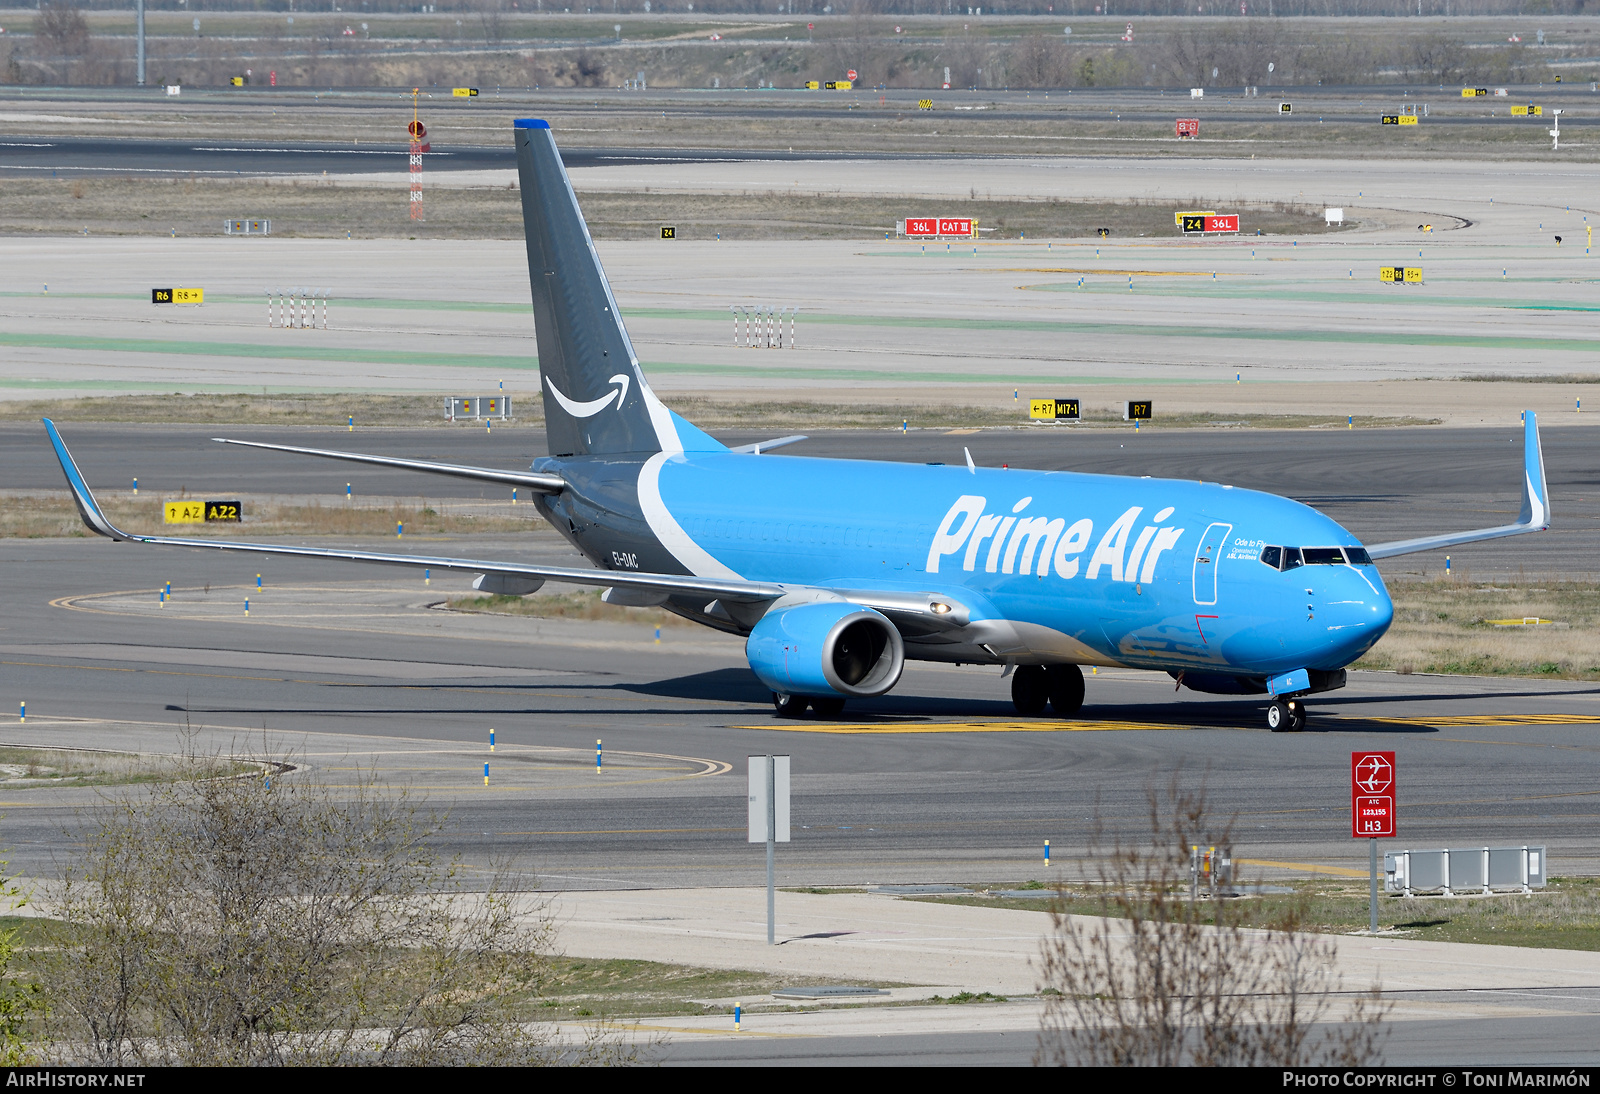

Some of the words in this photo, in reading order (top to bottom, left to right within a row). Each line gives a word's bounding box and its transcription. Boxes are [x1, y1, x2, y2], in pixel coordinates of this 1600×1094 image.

[913, 222, 929, 231] 36L
[942, 222, 958, 231] CAT
[960, 222, 968, 231] III
[1187, 219, 1201, 229] Z4
[1212, 219, 1231, 228] 36L
[664, 229, 672, 237] Z4
[156, 291, 169, 301] R6
[177, 291, 189, 300] R8
[1042, 403, 1052, 414] R7
[1057, 403, 1078, 415] M17-1
[1134, 404, 1147, 416] R7
[182, 507, 200, 519] AZ
[209, 505, 237, 519] AZ2
[926, 494, 1093, 580] Prime
[1085, 506, 1185, 584] Air
[1234, 538, 1248, 547] Ode
[1249, 539, 1255, 547] to
[1256, 540, 1266, 550] Fly
[612, 551, 639, 569] EI-DAC
[1365, 820, 1381, 831] H3
